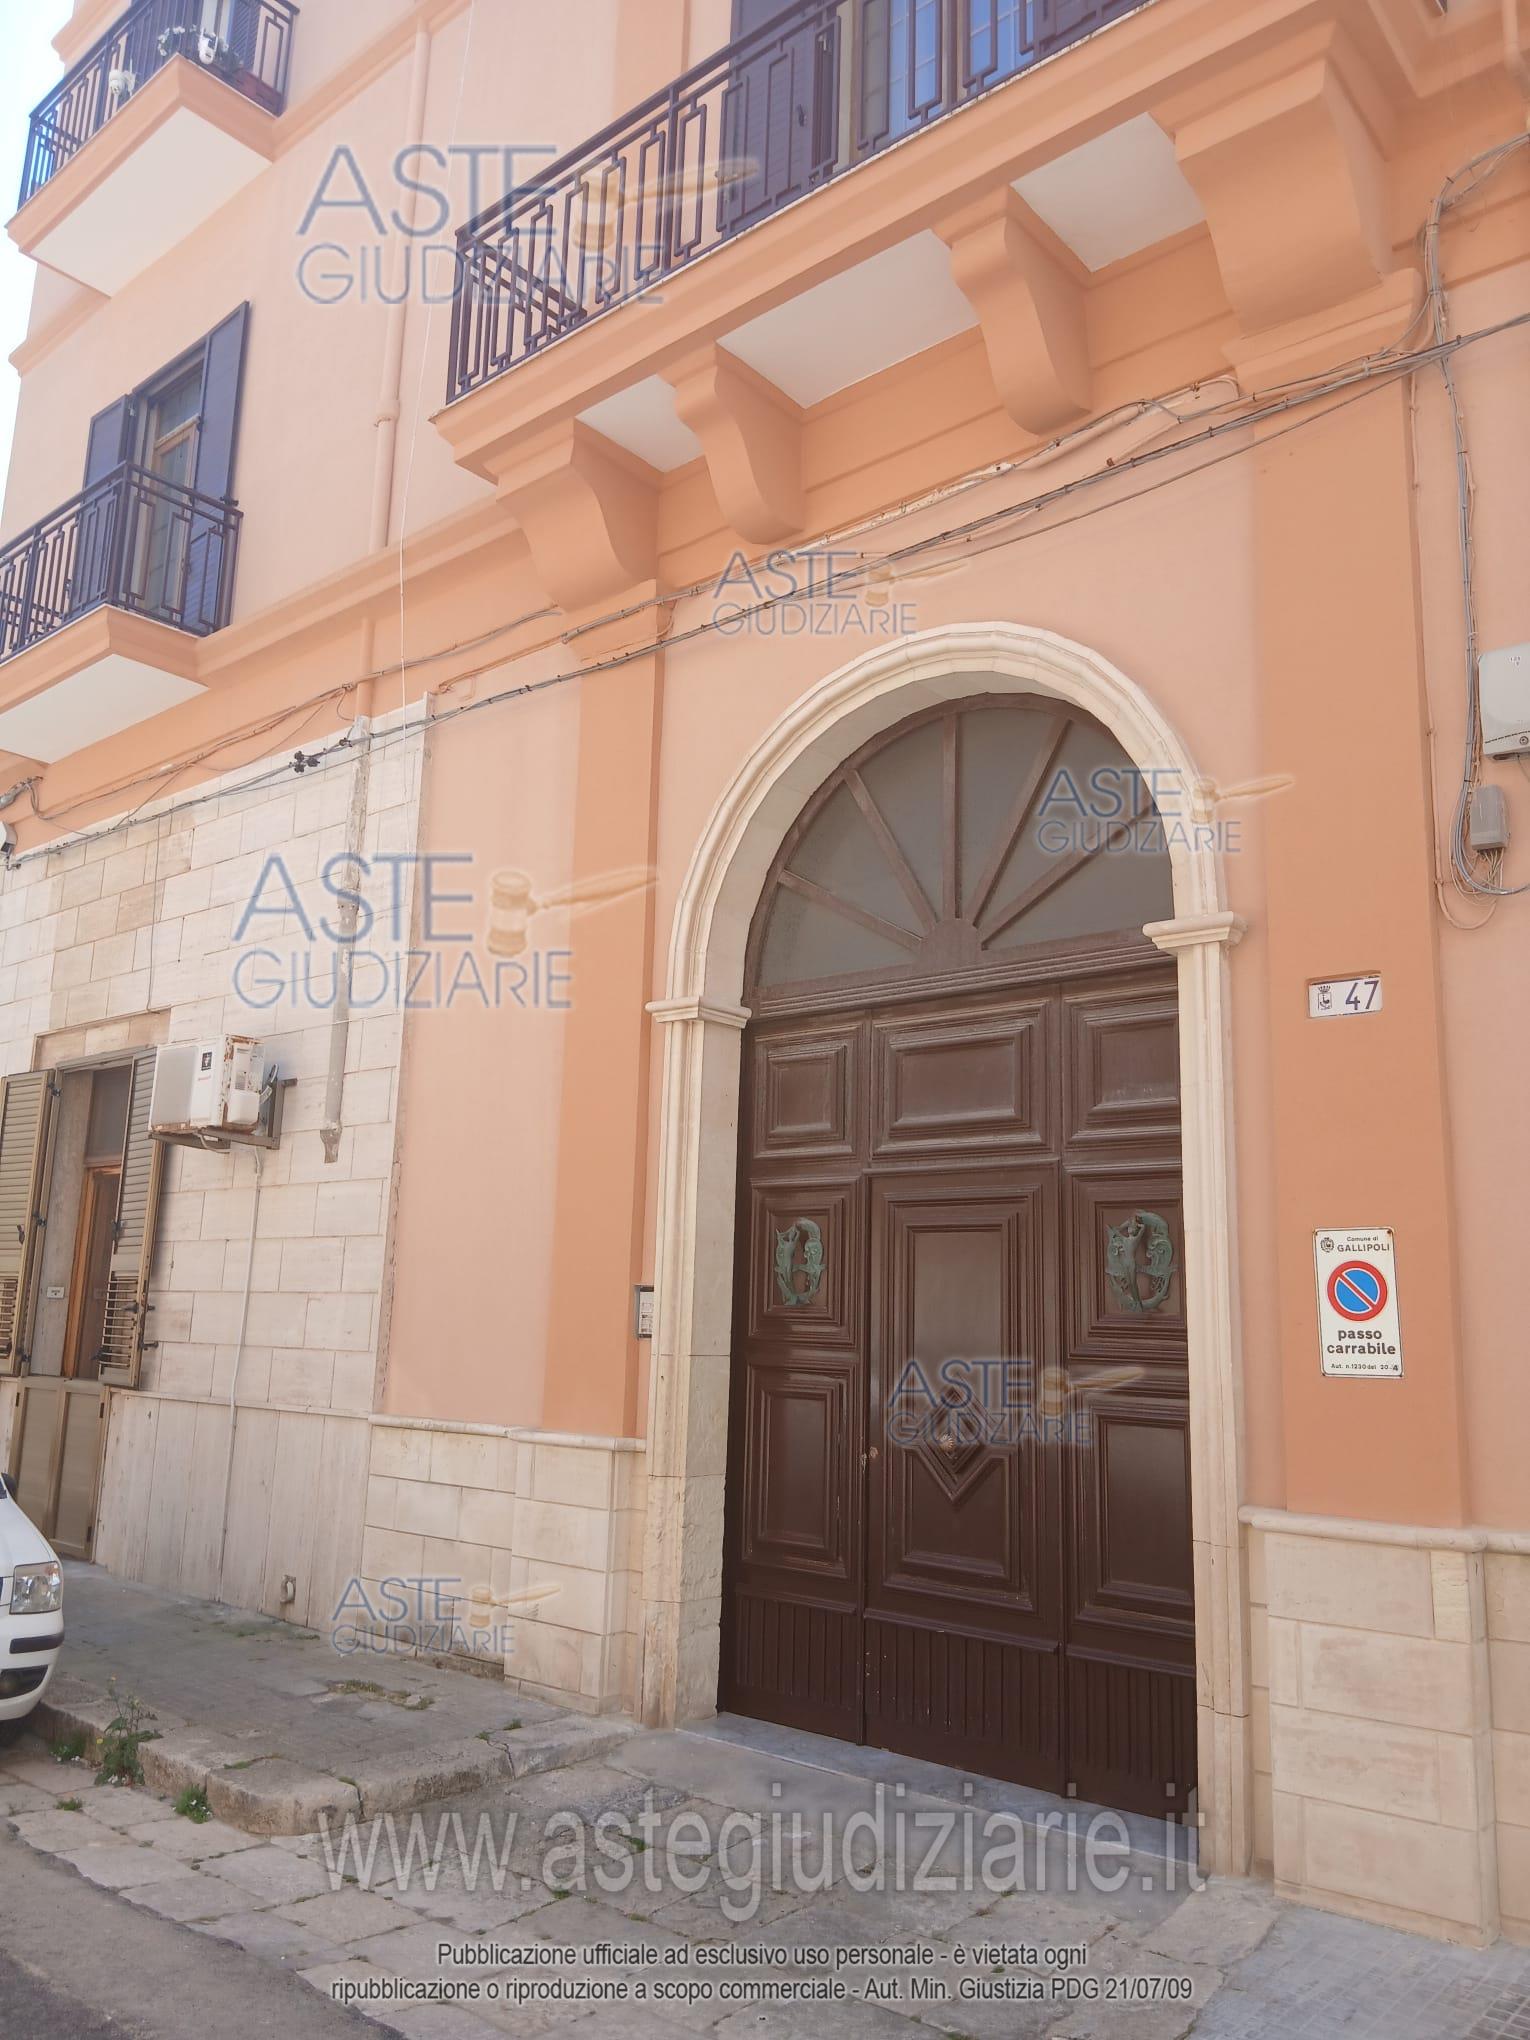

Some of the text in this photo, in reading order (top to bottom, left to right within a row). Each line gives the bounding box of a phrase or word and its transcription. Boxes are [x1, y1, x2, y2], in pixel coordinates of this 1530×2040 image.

[1345, 980, 1379, 1011] 47
[1337, 1243, 1390, 1252] GALLIPOLI
[1338, 1330, 1382, 1341] passo
[1327, 1342, 1396, 1355] carrabile
